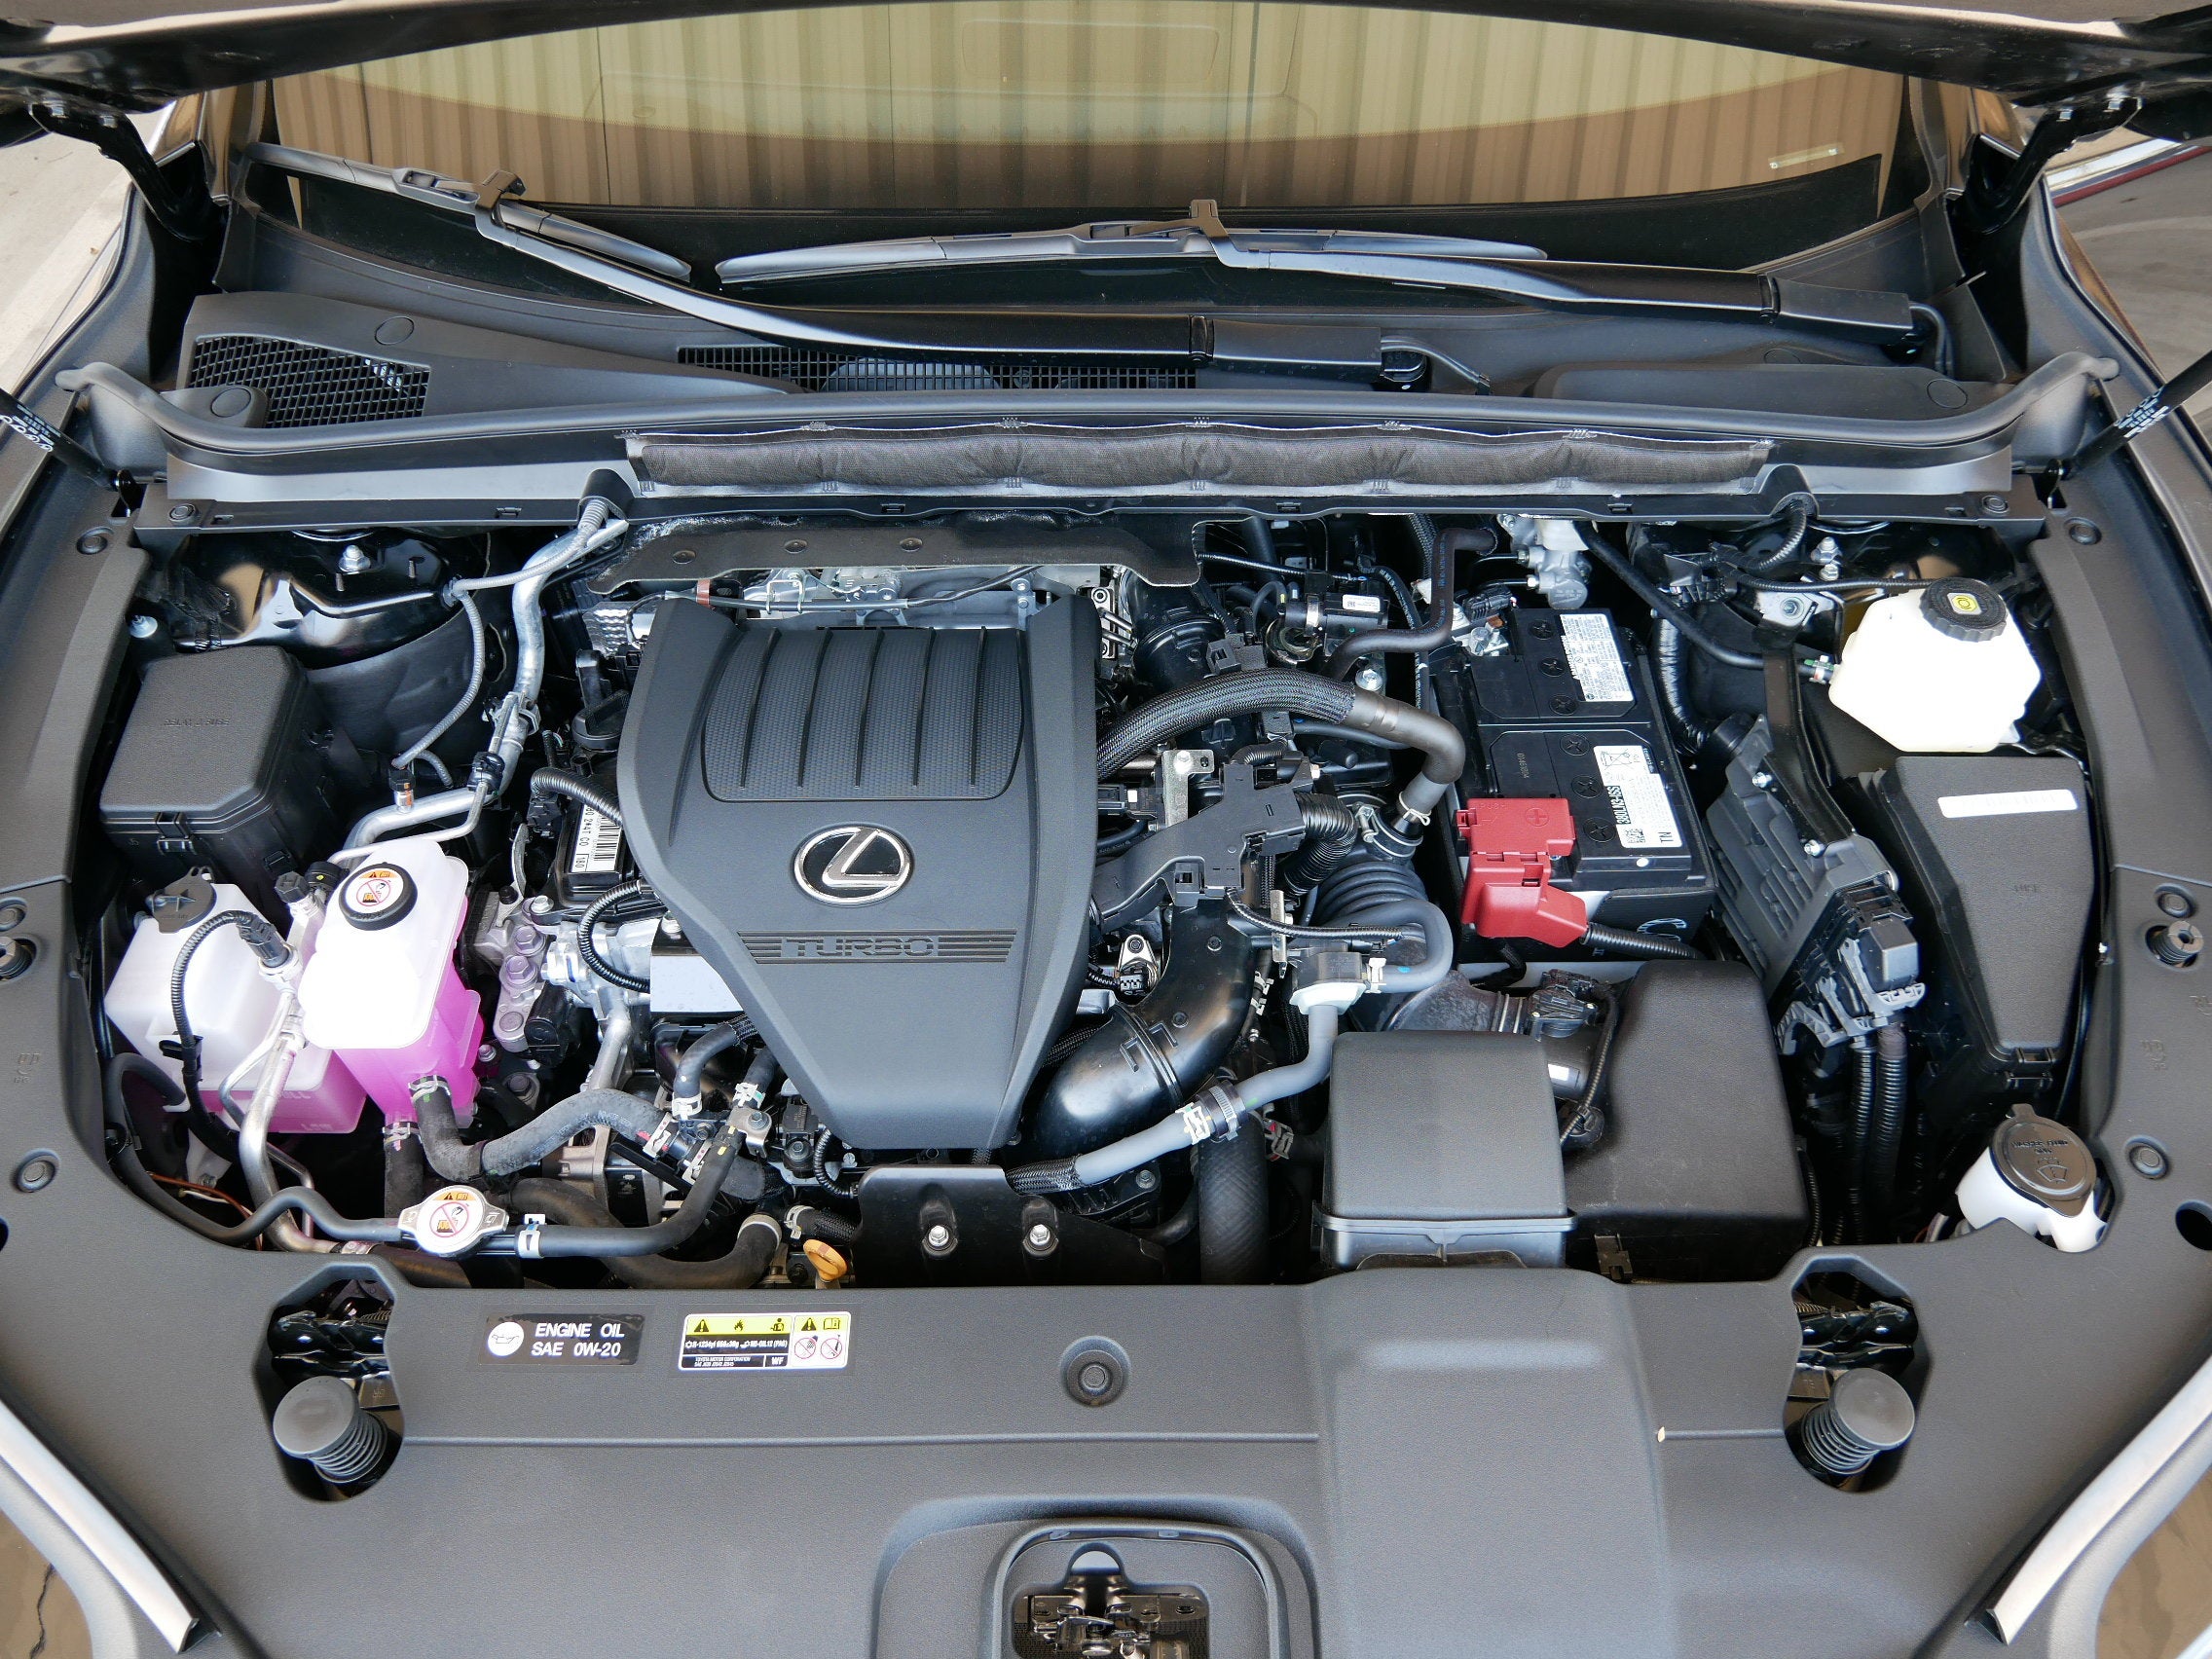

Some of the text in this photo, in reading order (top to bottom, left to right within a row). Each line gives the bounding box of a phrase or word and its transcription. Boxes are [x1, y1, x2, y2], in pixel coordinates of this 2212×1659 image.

[1657, 831, 1675, 844] TN
[785, 936, 935, 958] TURBO
[535, 1322, 625, 1338] ENGINE OIL
[531, 1341, 621, 1357] SAE 0W-20
